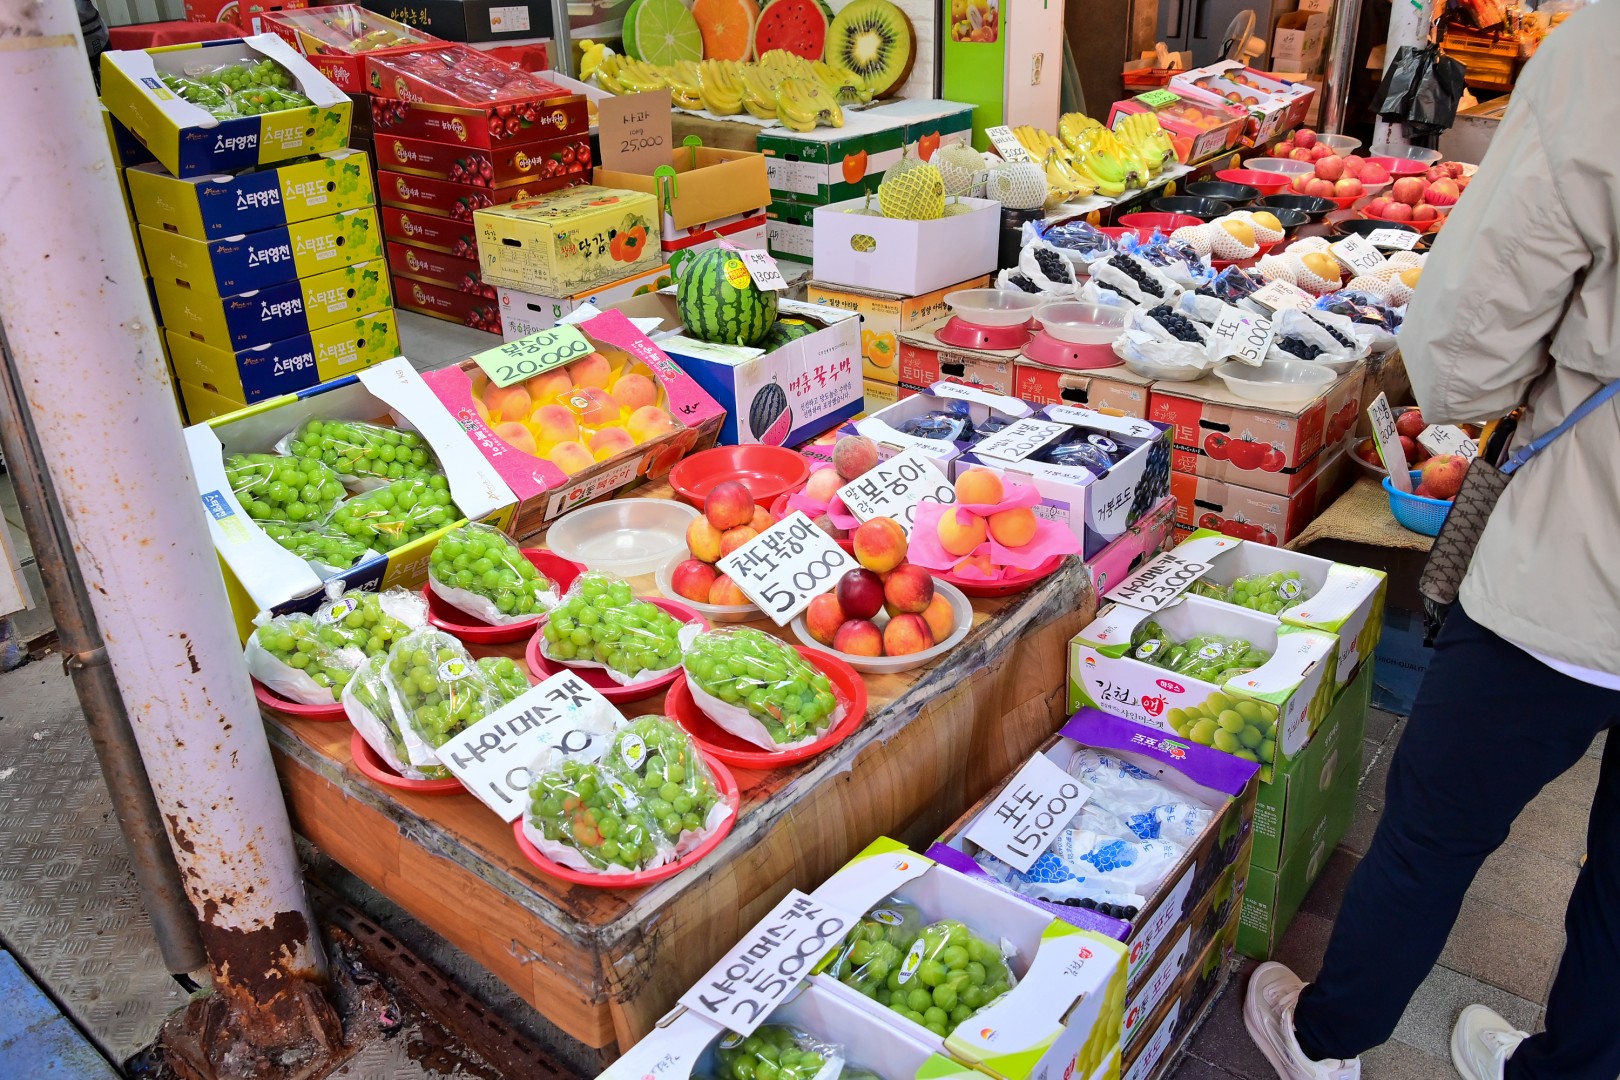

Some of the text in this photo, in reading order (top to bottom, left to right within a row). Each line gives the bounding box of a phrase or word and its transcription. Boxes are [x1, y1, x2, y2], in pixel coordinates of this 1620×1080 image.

[622, 111, 650, 125] 사과
[214, 133, 257, 154] 스타영천
[264, 125, 303, 146] 스타포도
[620, 135, 664, 154] 25,000
[519, 157, 542, 168] 아삭사과
[236, 188, 280, 211] 스타영천
[286, 179, 326, 201] 스타포도
[248, 244, 290, 268] 스타영천
[296, 233, 336, 256] 스타포도
[578, 233, 606, 258] 단감
[1345, 239, 1359, 252] 배
[753, 270, 781, 285] 13,000
[261, 297, 302, 321] 스타영천
[308, 287, 347, 309] 스타포도
[1215, 315, 1241, 342] 포도
[273, 351, 314, 377] 스타영천
[318, 339, 356, 362] 스타포도
[500, 331, 562, 358] 복숭아
[634, 339, 661, 363] 복숭아
[495, 340, 589, 382] 20.000
[788, 370, 812, 397] 명품
[902, 366, 935, 385] 토마토
[474, 429, 503, 457] 복숭아
[1010, 422, 1040, 438] 거봉
[913, 440, 948, 457] 거봉포도
[596, 468, 631, 490] 복숭아
[857, 456, 928, 506] 복숭아
[1043, 468, 1080, 482] 거봉포도
[1097, 486, 1132, 522] 거봉포도
[729, 516, 820, 582] 천도복숭아
[1116, 551, 1188, 600] 샤인머스캣
[1139, 562, 1206, 607] 23.000
[1378, 655, 1428, 673] HIGH-QUALIT
[1095, 679, 1140, 707] 김천
[1143, 696, 1159, 716] 앤
[1159, 679, 1183, 693] 하우스
[449, 677, 593, 771] 샤인머스캣
[1133, 732, 1159, 748] 포도
[993, 783, 1044, 830] 포도
[1006, 783, 1080, 858] 15.000
[1153, 901, 1175, 941] 포도
[697, 896, 825, 1014] 샤인머스캣
[730, 916, 845, 1025] 25.000
[1151, 963, 1173, 1000] 포도
